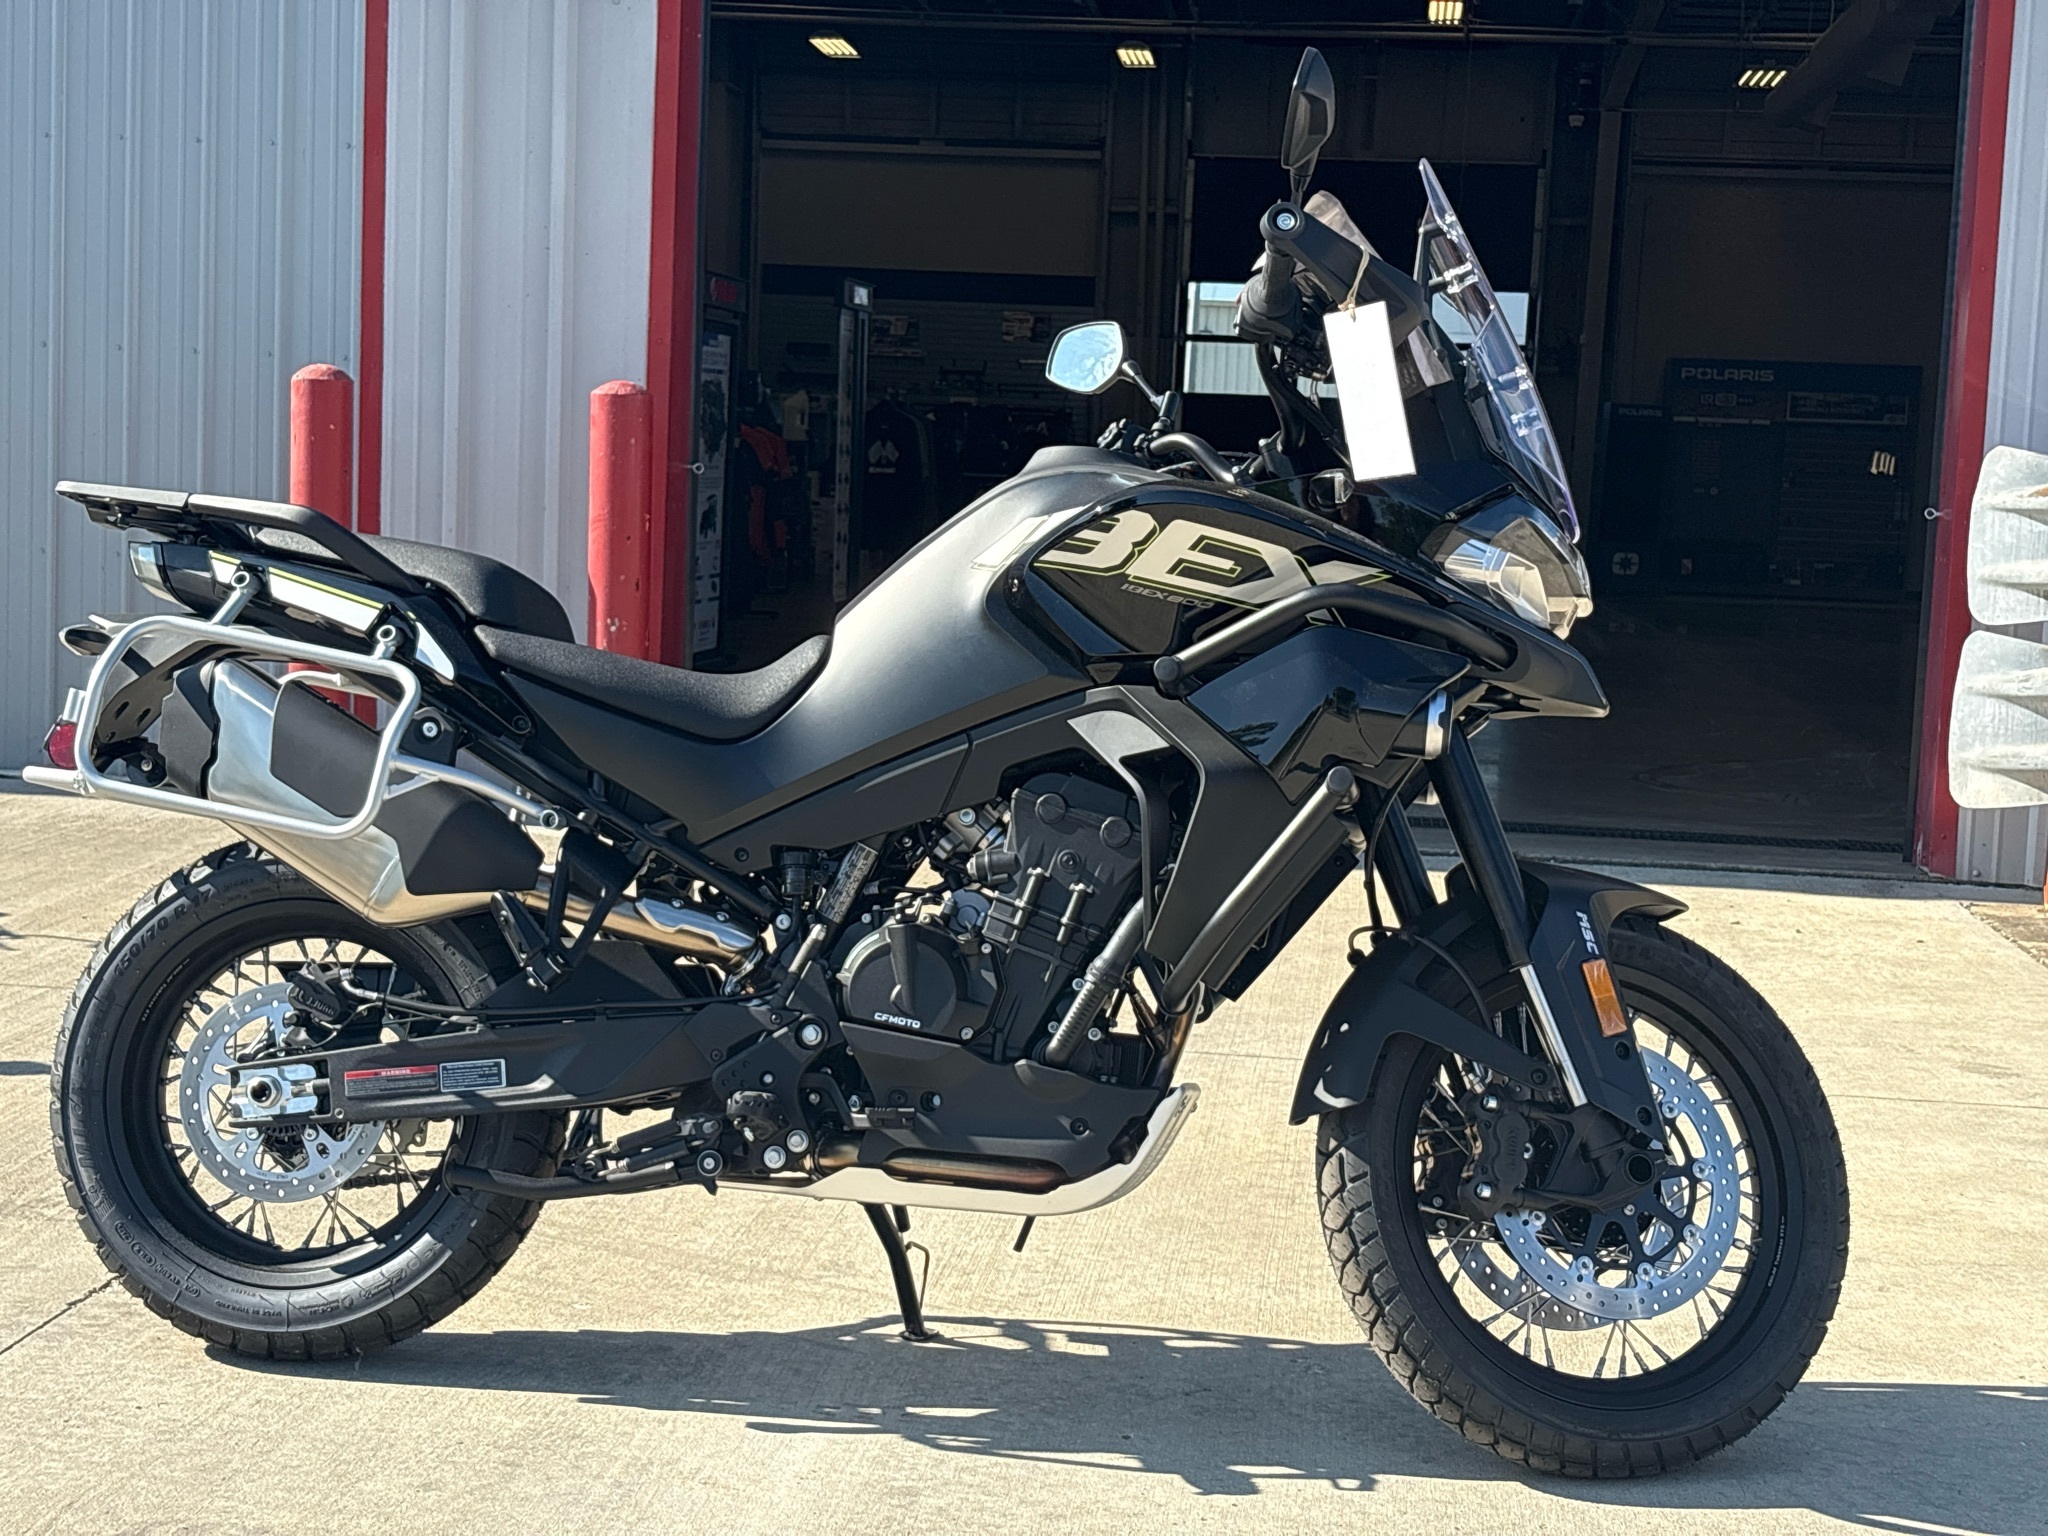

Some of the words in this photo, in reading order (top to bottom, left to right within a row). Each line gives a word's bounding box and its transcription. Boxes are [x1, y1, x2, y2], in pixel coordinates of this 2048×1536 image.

[1680, 367, 1775, 382] POLARIS
[1618, 406, 1663, 418] POLARIS
[1120, 582, 1169, 600] IBEX
[114, 916, 170, 977] 150/70
[173, 904, 188, 918] R
[1575, 910, 1600, 956] MSC
[874, 1012, 921, 1029] CFMOTO
[381, 1068, 411, 1076] WARNING
